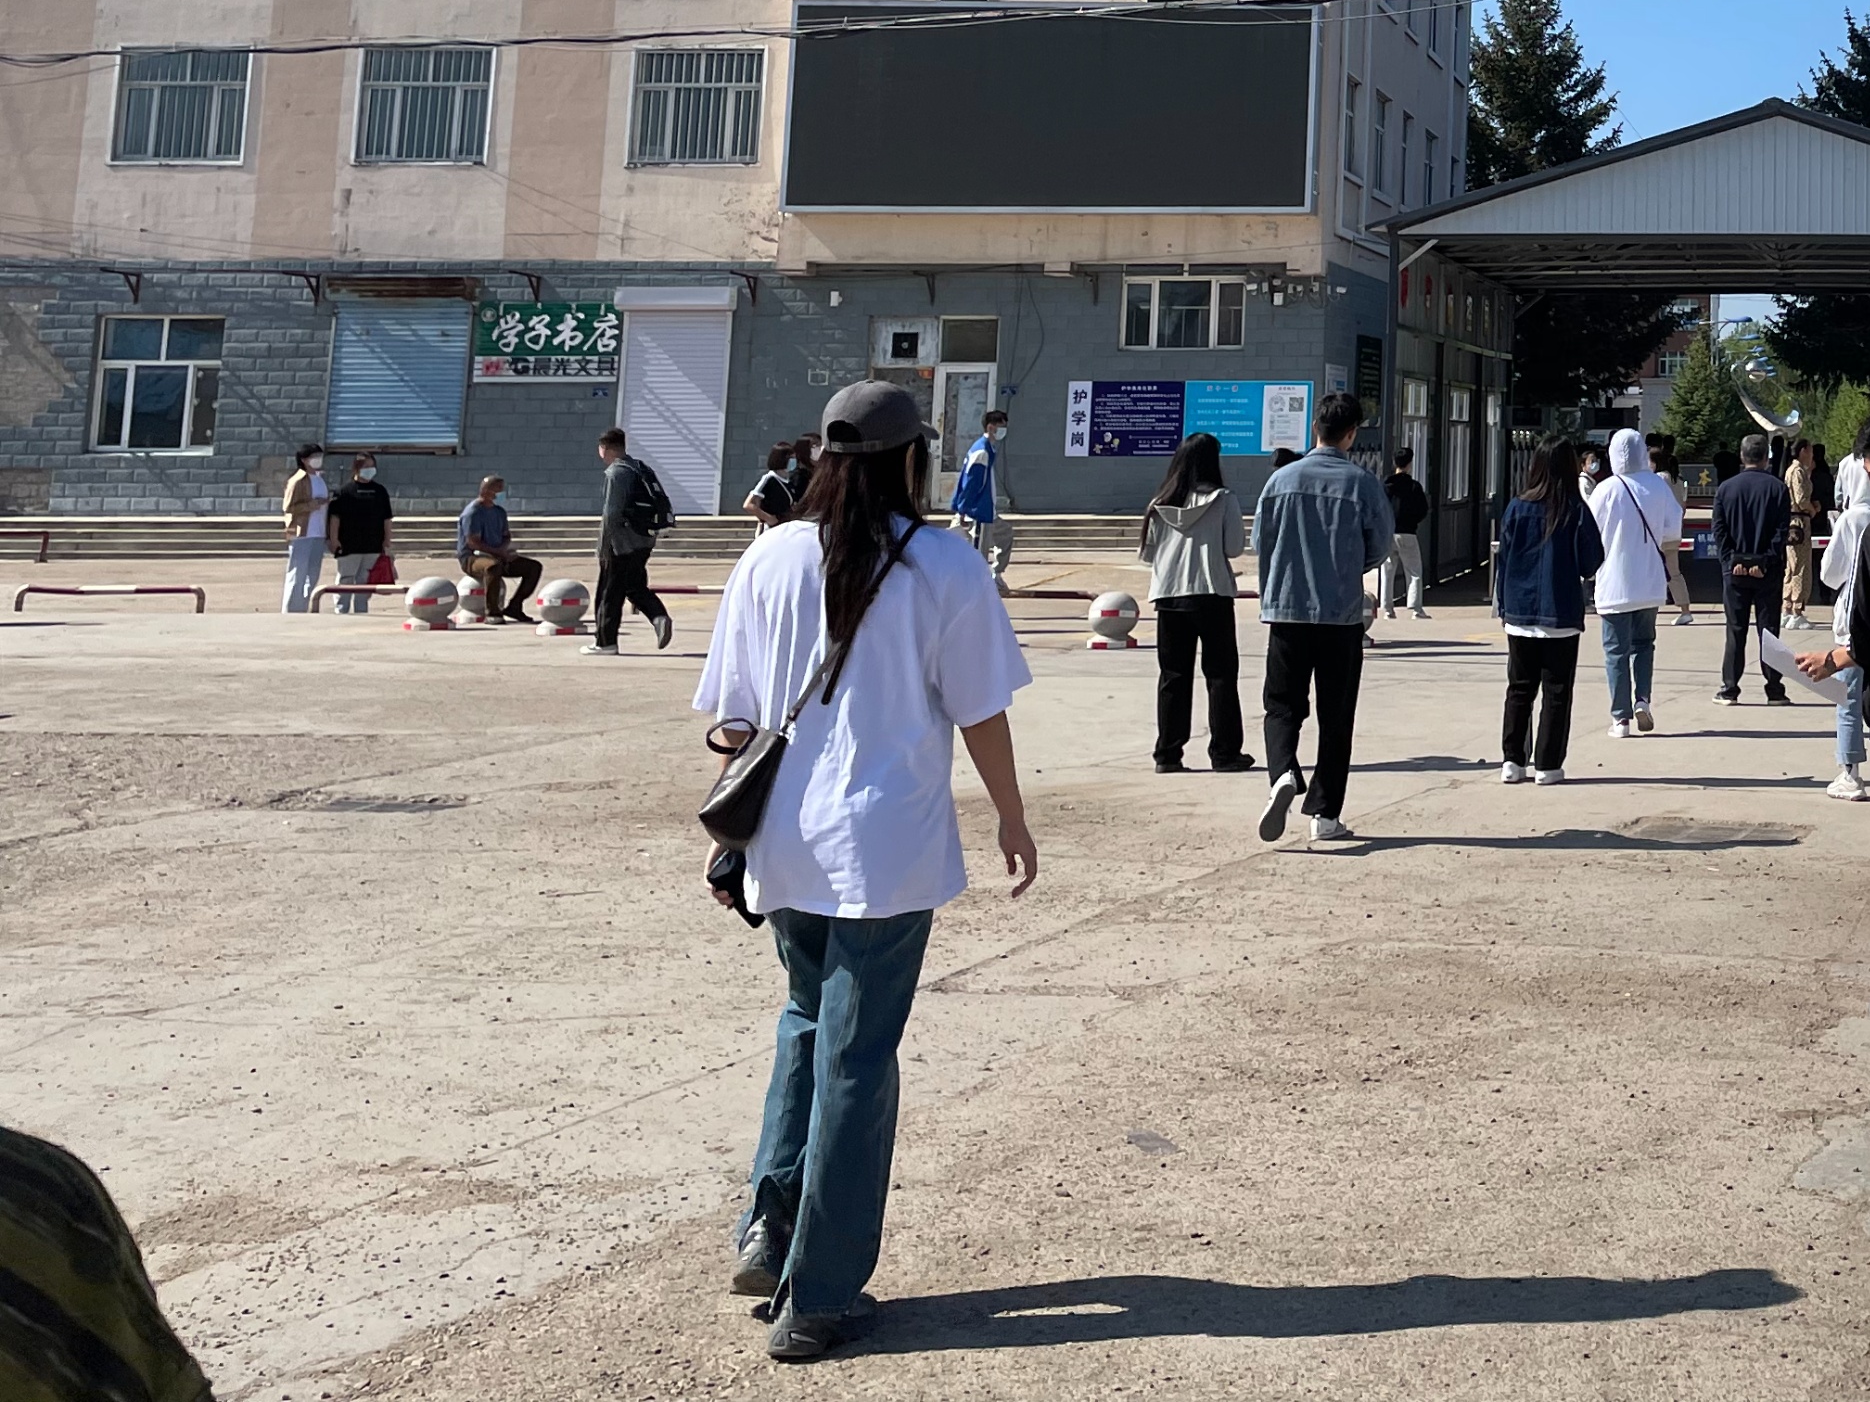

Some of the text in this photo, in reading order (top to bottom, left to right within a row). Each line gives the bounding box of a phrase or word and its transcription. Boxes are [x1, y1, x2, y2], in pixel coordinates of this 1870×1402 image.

[491, 311, 620, 352] 学子书店
[1070, 389, 1088, 447] 护学岗
